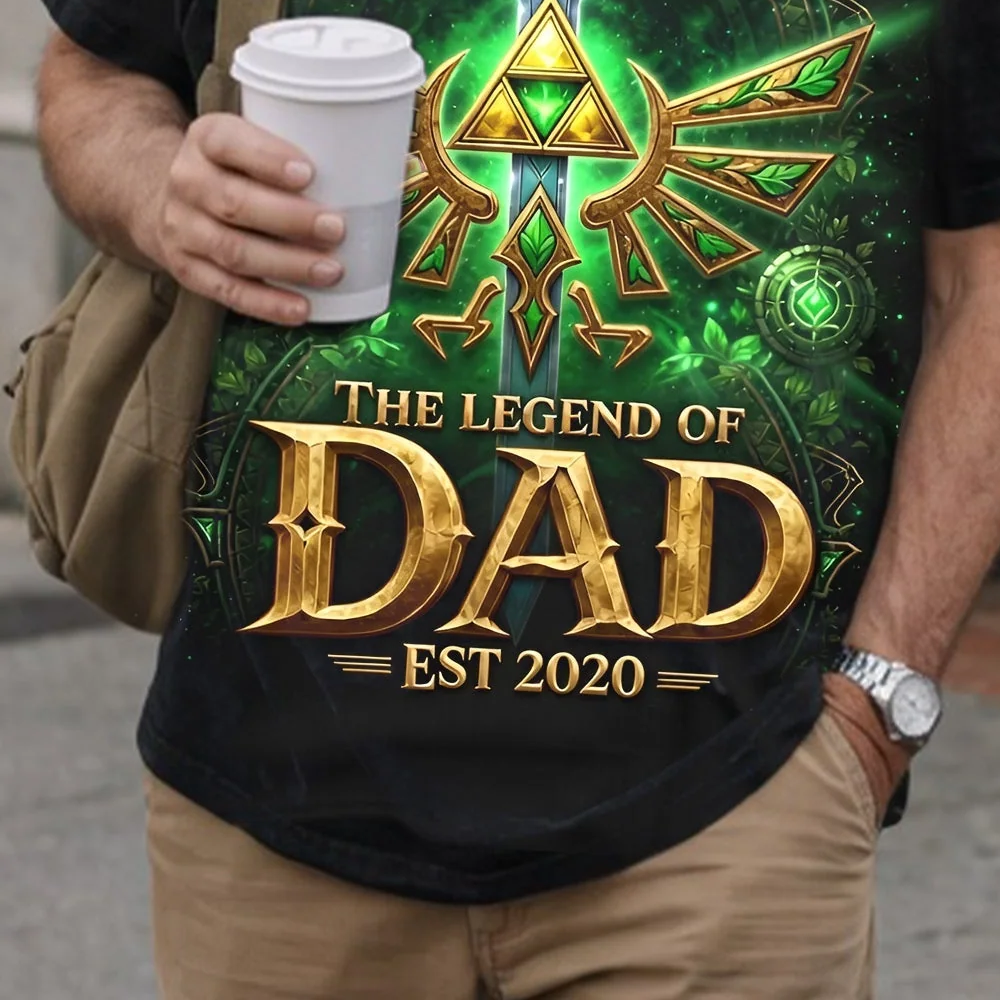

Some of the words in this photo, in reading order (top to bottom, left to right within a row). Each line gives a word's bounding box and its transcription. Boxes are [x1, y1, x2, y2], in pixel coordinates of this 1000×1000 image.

[334, 379, 444, 428] THE
[458, 392, 662, 440] LEGEND
[677, 404, 746, 445] OF
[235, 419, 816, 640] DAD
[400, 642, 502, 691] EST
[513, 649, 645, 698] 2020
